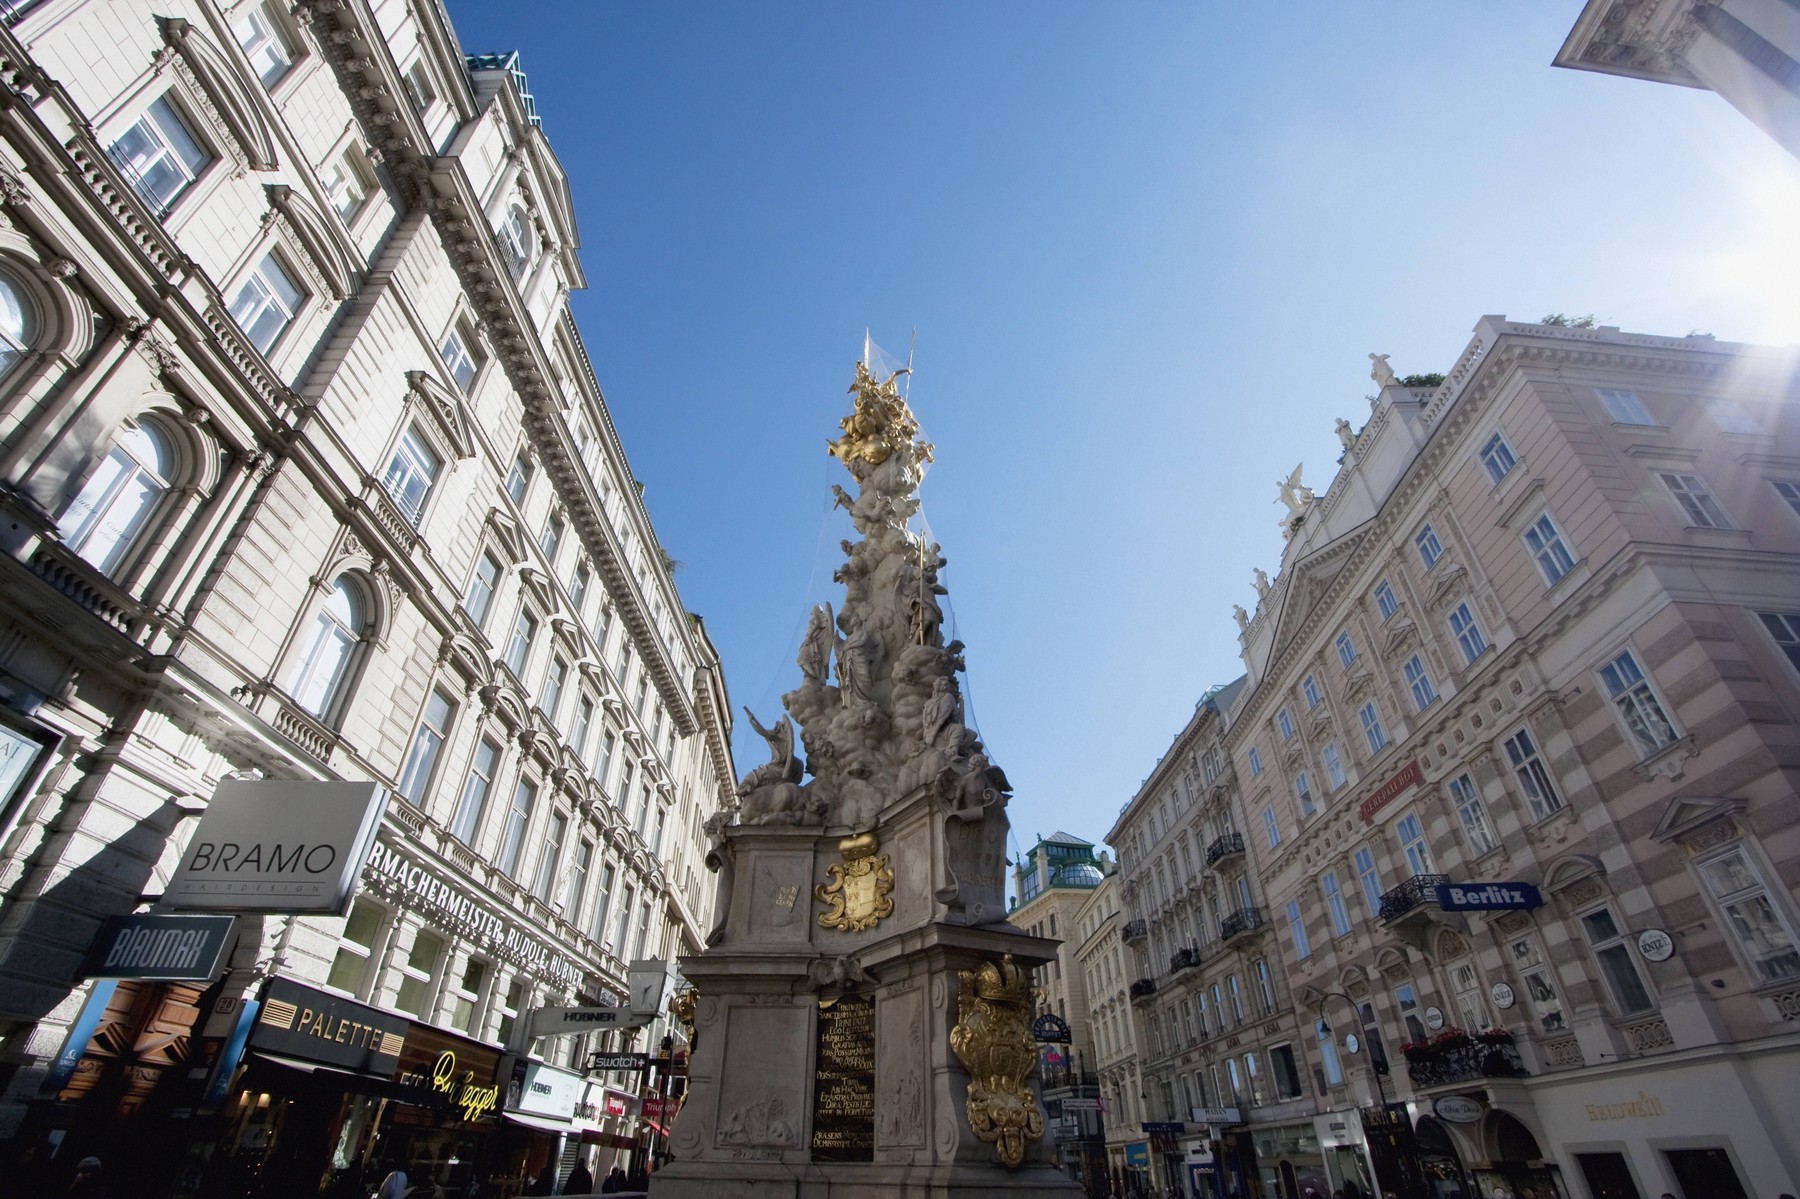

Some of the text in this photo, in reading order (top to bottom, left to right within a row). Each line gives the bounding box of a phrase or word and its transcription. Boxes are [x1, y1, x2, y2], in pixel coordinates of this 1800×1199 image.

[1363, 768, 1415, 815] GENERALI HOF
[189, 842, 336, 874] BRAMO
[1449, 886, 1525, 905] Berlitz
[297, 1008, 382, 1052] PALETTE
[595, 1055, 638, 1067] swatch
